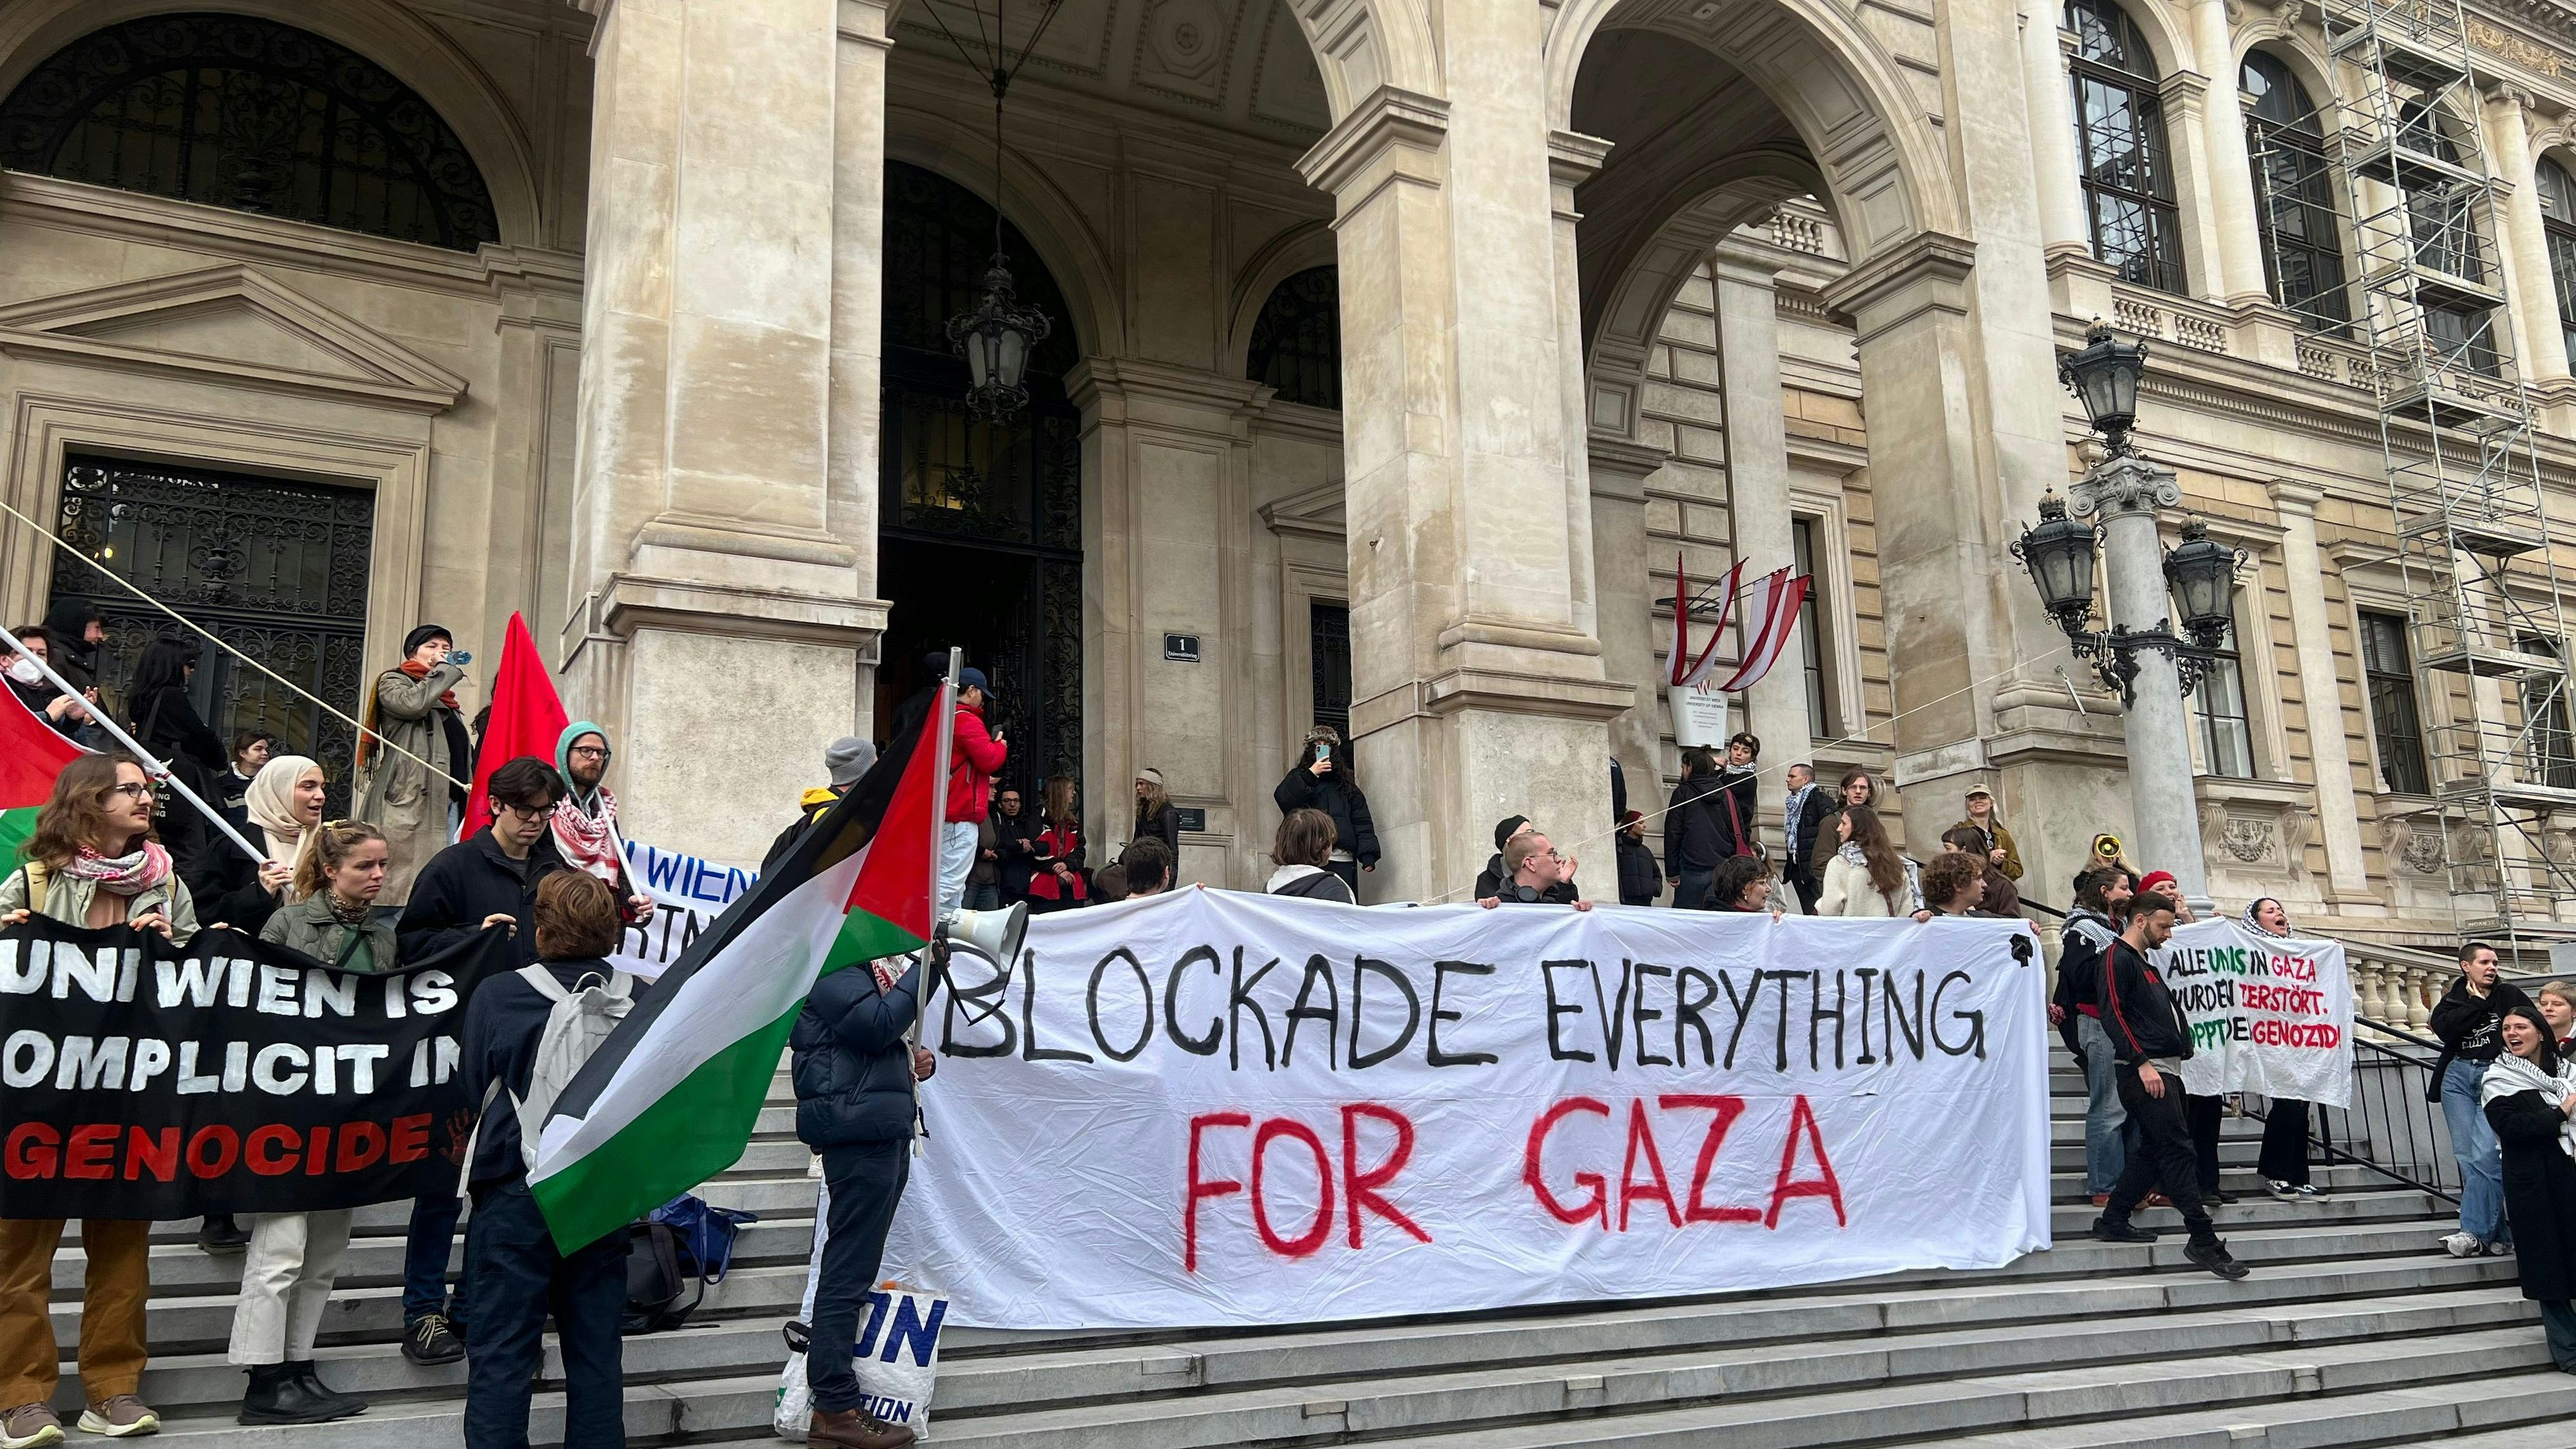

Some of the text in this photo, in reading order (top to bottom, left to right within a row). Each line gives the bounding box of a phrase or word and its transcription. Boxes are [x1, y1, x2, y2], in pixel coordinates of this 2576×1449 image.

[1180, 639, 1185, 650] 1
[2499, 649, 2530, 662] XERVON
[0, 938, 460, 1019] UNI WIEN IS
[2166, 945, 2316, 983] ALLE UNIS IN GAZA
[940, 943, 1987, 1072] BLOCKADE EVERYTHING
[2239, 983, 2329, 1016] ZERSTÖRT.
[2253, 1019, 2341, 1049] GENOZID!
[4, 1113, 433, 1183] GENOCIDE
[1184, 1093, 1846, 1274] FOR GAZA
